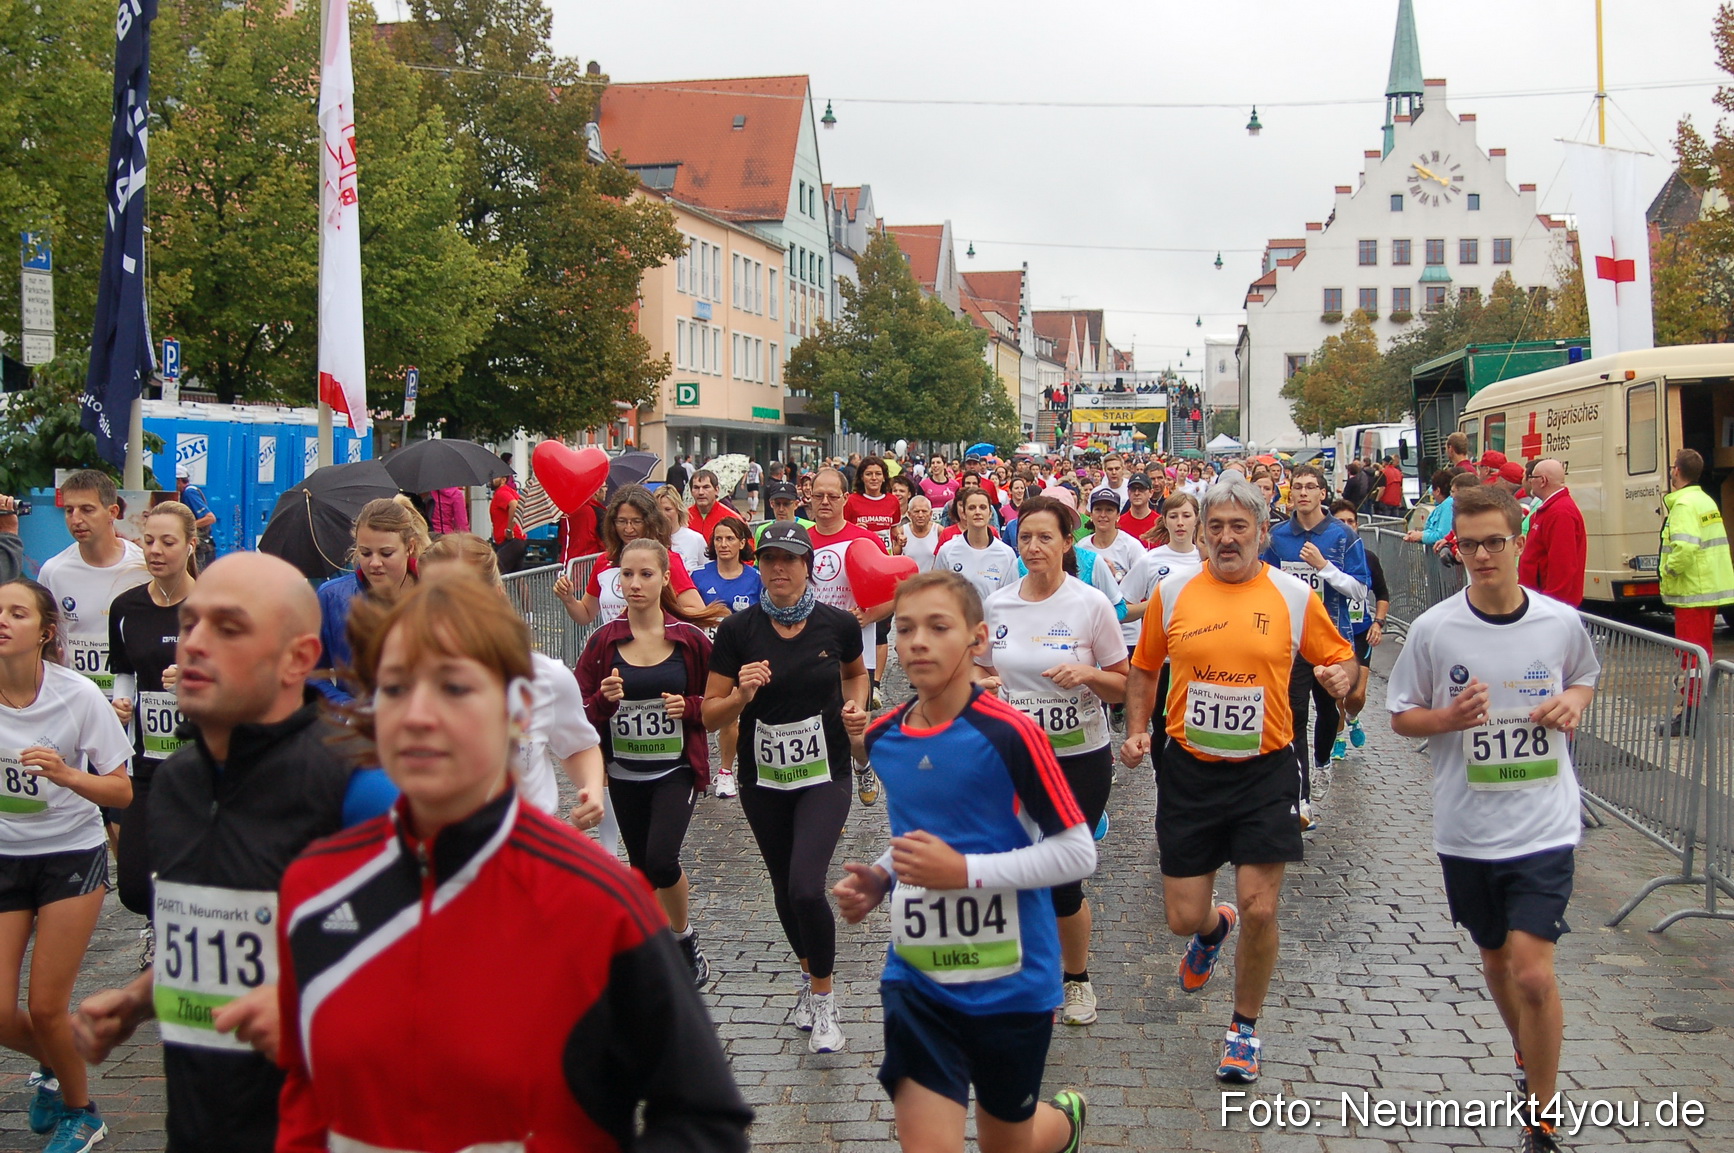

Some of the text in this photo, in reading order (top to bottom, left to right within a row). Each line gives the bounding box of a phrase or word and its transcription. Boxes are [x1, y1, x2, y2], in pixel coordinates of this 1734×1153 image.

[166, 345, 176, 374] P
[408, 373, 416, 394] P
[679, 386, 696, 403] D
[1102, 412, 1135, 420] START
[1546, 402, 1599, 430] Bayerisches
[1546, 432, 1570, 452] Rotes
[1625, 486, 1654, 500] Bayerisches
[68, 640, 88, 648] PARTL
[1193, 664, 1256, 684] WERNER
[142, 697, 160, 706] PARTL
[1010, 698, 1034, 706] PARTL
[1189, 688, 1251, 702] PARTL Neumarkt
[617, 712, 676, 736] 5135
[1018, 706, 1080, 731] 188
[1192, 700, 1256, 731] 5152
[756, 726, 812, 738] PARTL Neumarkt
[628, 742, 666, 751] Ramona
[760, 734, 820, 766] 5134
[1473, 726, 1549, 761] 5128
[774, 768, 808, 782] Brigitte
[1500, 768, 1526, 779] Nico
[157, 898, 249, 921] PARTL Neumarkt
[904, 894, 1007, 938] 5104
[166, 922, 266, 988] 5113
[932, 950, 980, 966] Lukas
